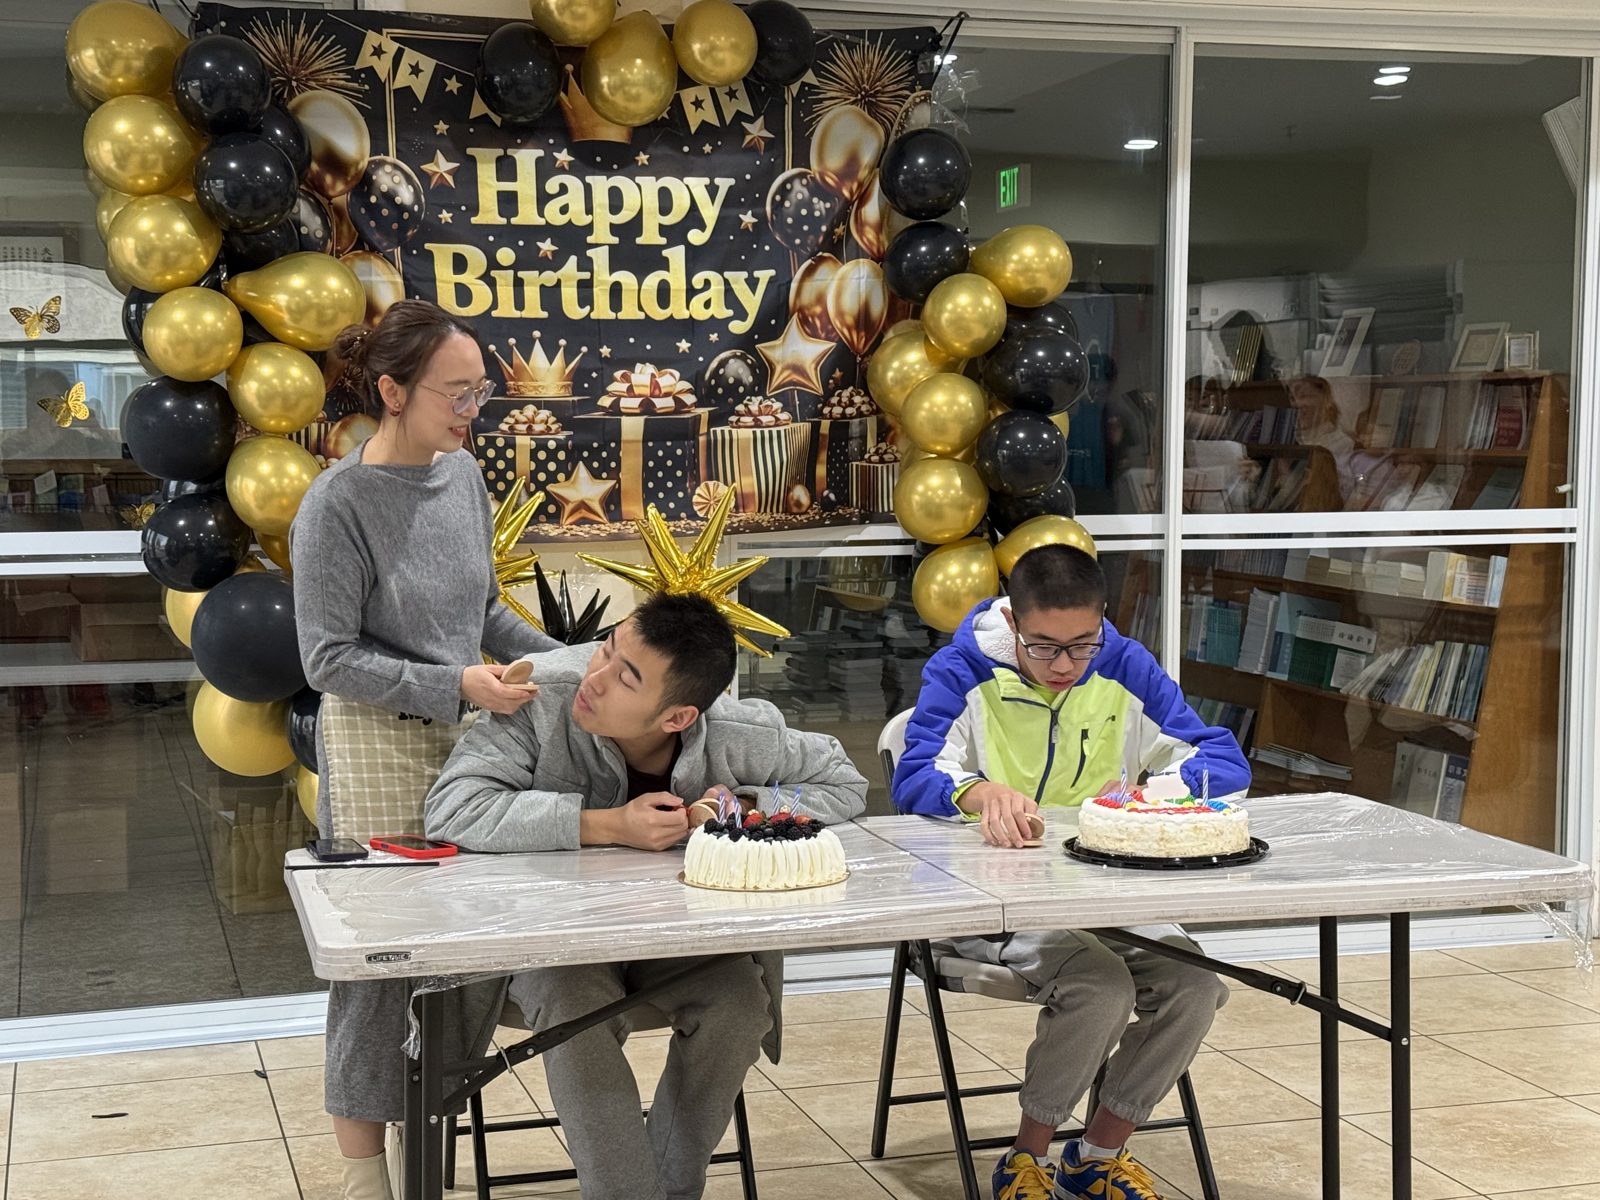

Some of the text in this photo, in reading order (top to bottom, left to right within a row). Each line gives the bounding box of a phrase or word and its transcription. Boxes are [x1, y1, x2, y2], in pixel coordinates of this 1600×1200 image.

[466, 147, 736, 246] Happy
[1000, 167, 1019, 208] EXIT
[424, 242, 776, 335] Birthday
